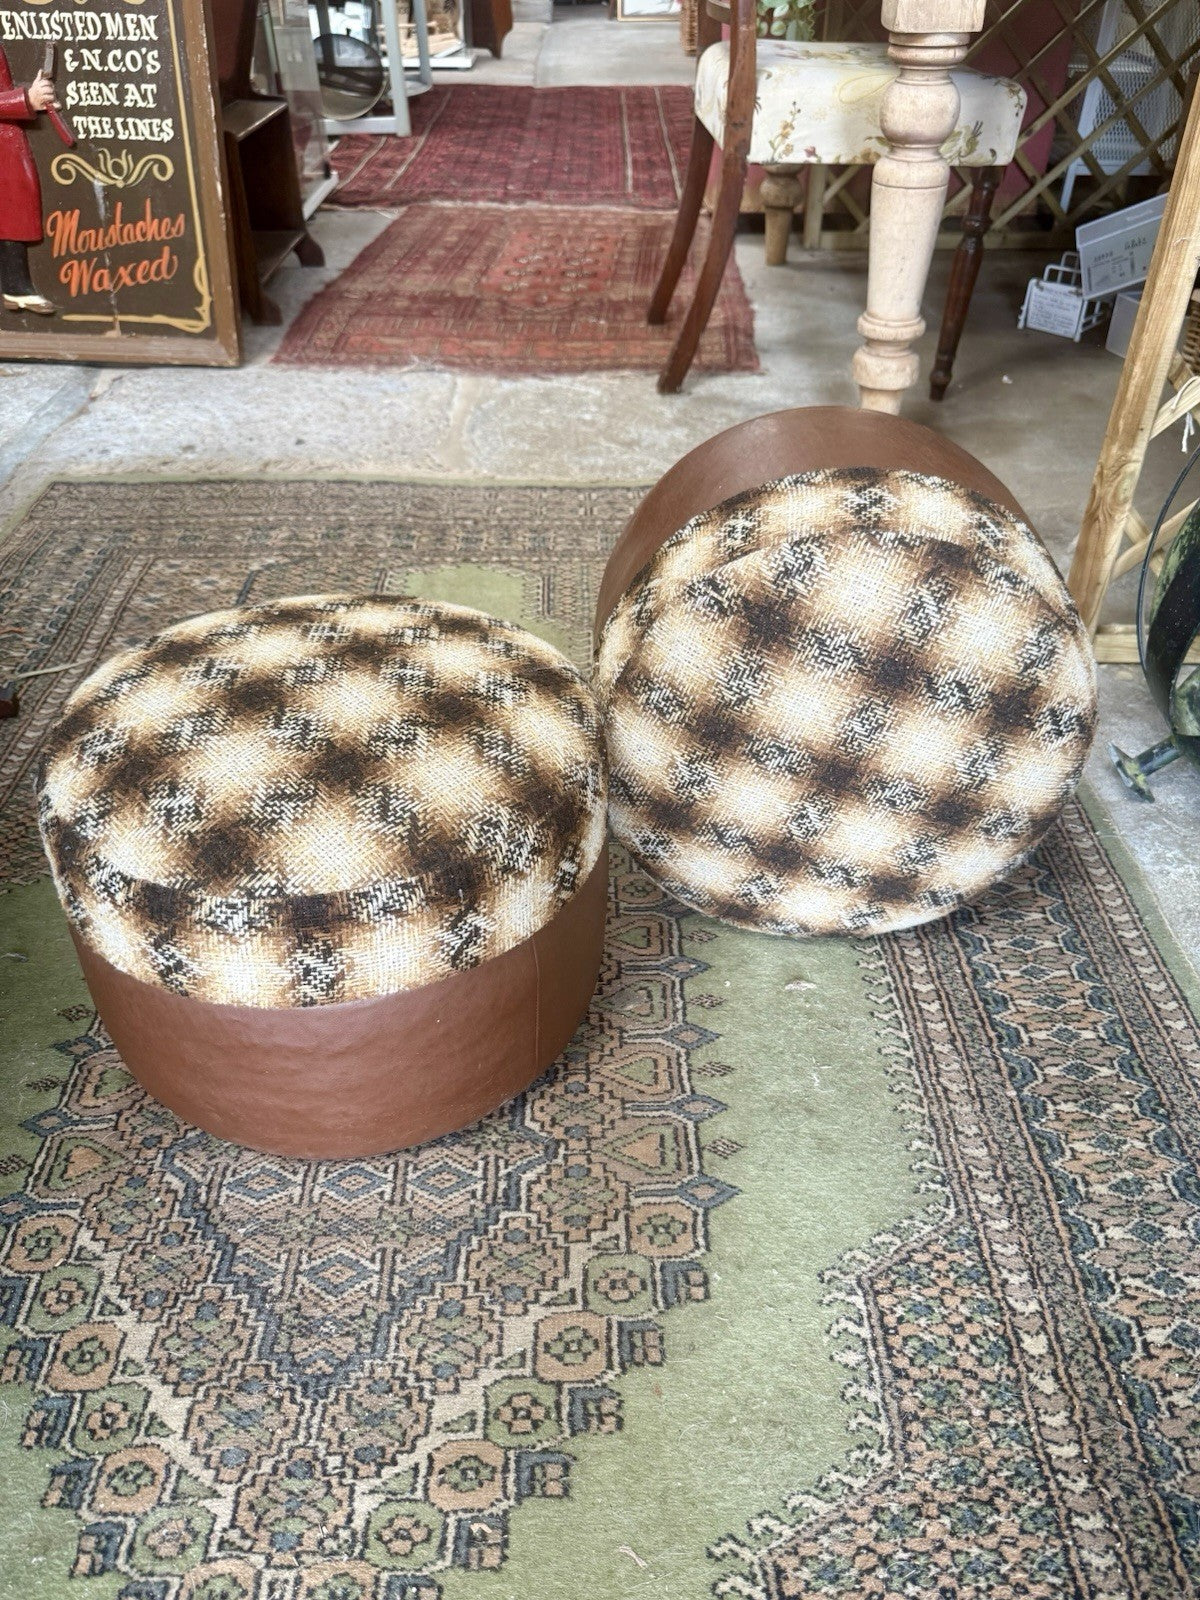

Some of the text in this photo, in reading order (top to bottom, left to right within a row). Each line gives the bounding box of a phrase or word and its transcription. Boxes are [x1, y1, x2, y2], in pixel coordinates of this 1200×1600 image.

[0, 10, 159, 41] ENLISTED MEN
[66, 80, 157, 110] SEEN AT
[72, 115, 175, 143] THE LINES
[46, 198, 186, 258] Moustaches
[59, 245, 178, 297] Waxed
